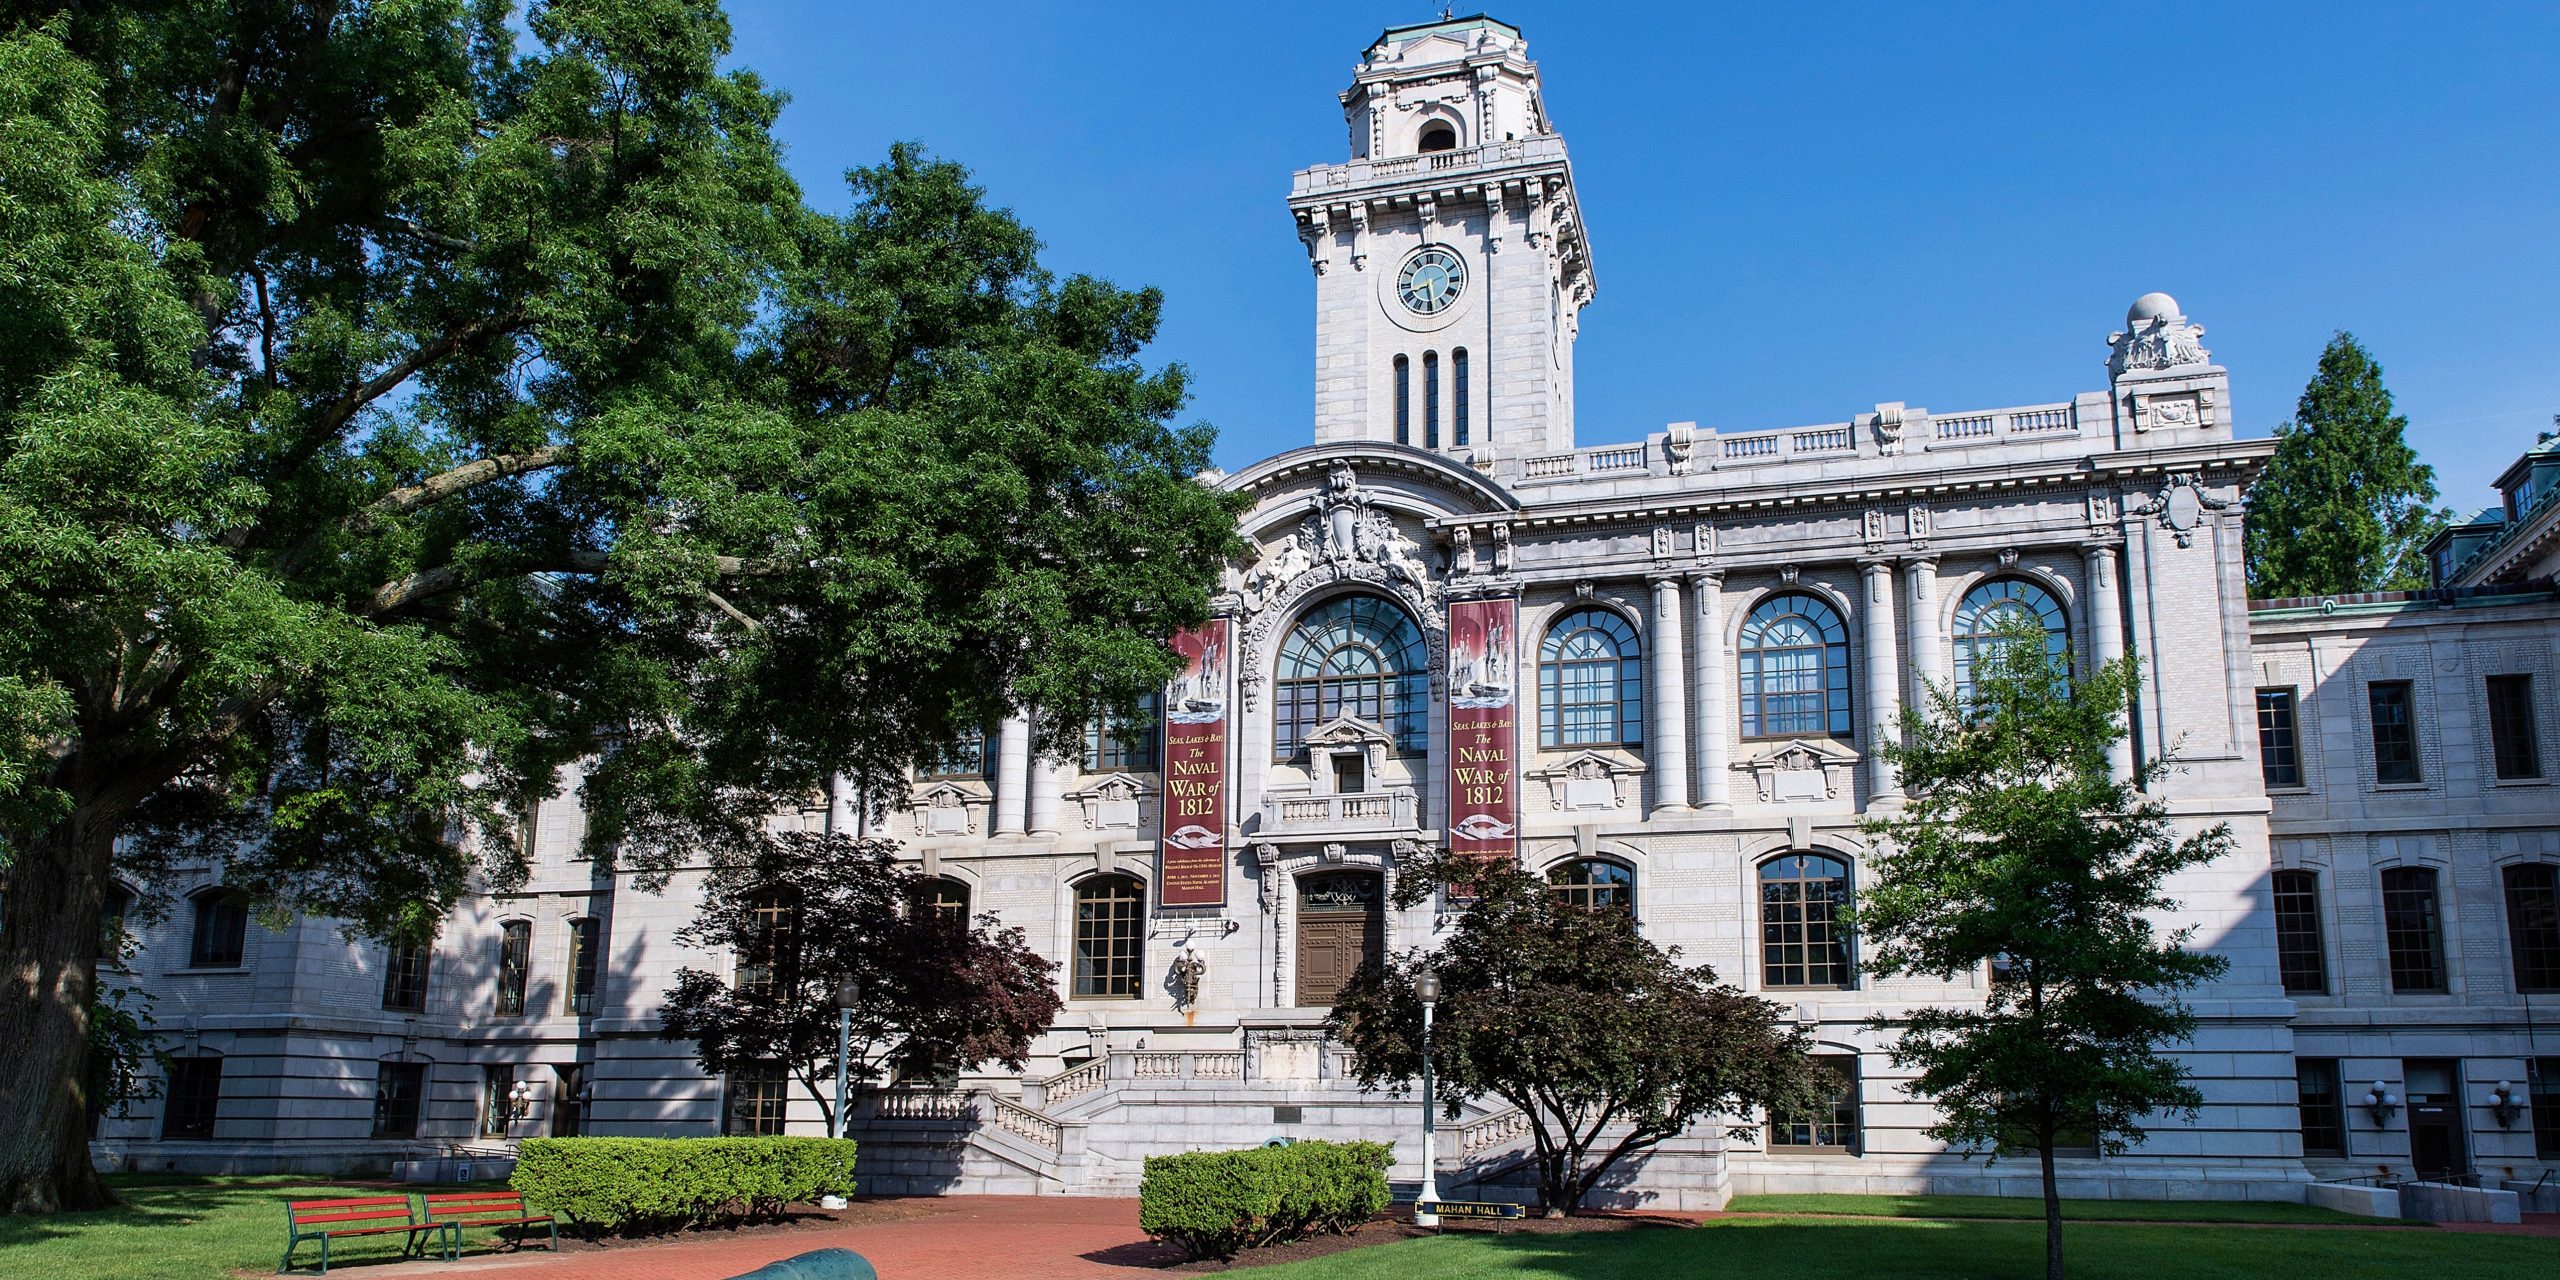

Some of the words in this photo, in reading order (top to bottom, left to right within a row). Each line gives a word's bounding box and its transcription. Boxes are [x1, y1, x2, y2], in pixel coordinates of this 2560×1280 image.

[1470, 720, 1491, 730] LAKES
[1186, 735, 1204, 744] LAKES
[1475, 734, 1491, 744] The
[1190, 748, 1204, 758] The
[1459, 747, 1508, 763] NAVAL
[1174, 760, 1218, 775] NAVAL
[1454, 767, 1495, 785] WAR
[1498, 768, 1512, 784] of
[1169, 780, 1206, 797] WAR
[1208, 781, 1222, 796] of
[1466, 786, 1504, 805] 1812
[1179, 798, 1214, 816] 1812
[1436, 1204, 1472, 1214] MAHAN
[1477, 1206, 1502, 1216] HALL
